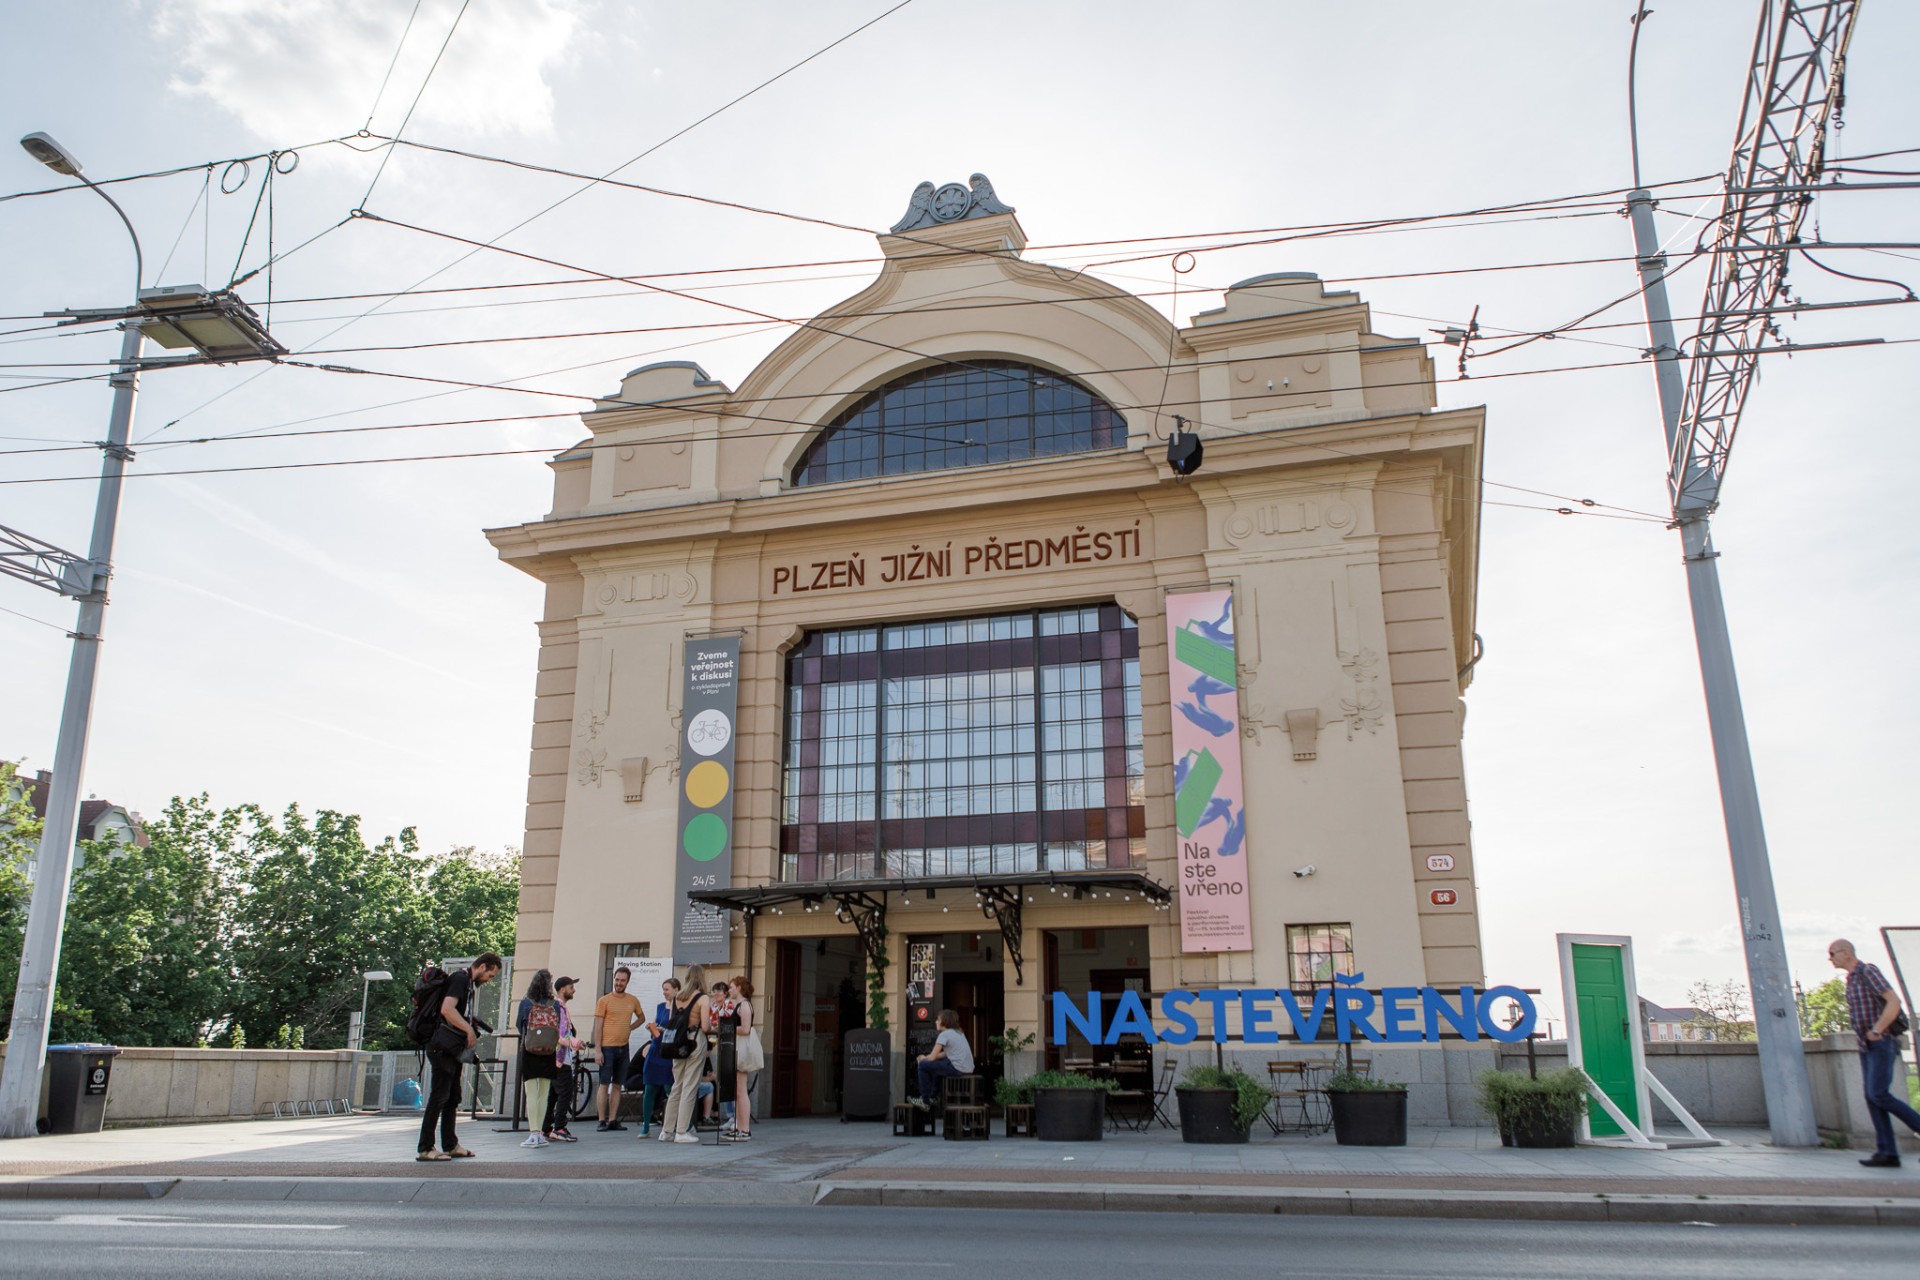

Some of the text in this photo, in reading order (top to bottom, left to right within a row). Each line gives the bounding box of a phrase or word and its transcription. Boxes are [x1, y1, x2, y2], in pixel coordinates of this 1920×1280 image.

[773, 519, 1141, 595] PLZEŇ JIŽNÍ PŘEDMĚSTÍ
[697, 651, 728, 660] Zveme
[691, 660, 734, 671] veřejnost
[691, 669, 732, 681] k diskusi
[1184, 842, 1210, 860] Na
[1431, 858, 1449, 868] 574
[1185, 863, 1216, 879] ste
[692, 875, 716, 887] 24/5
[1185, 879, 1243, 896] vřeno
[1053, 972, 1537, 1045] NASTEVŘENO
